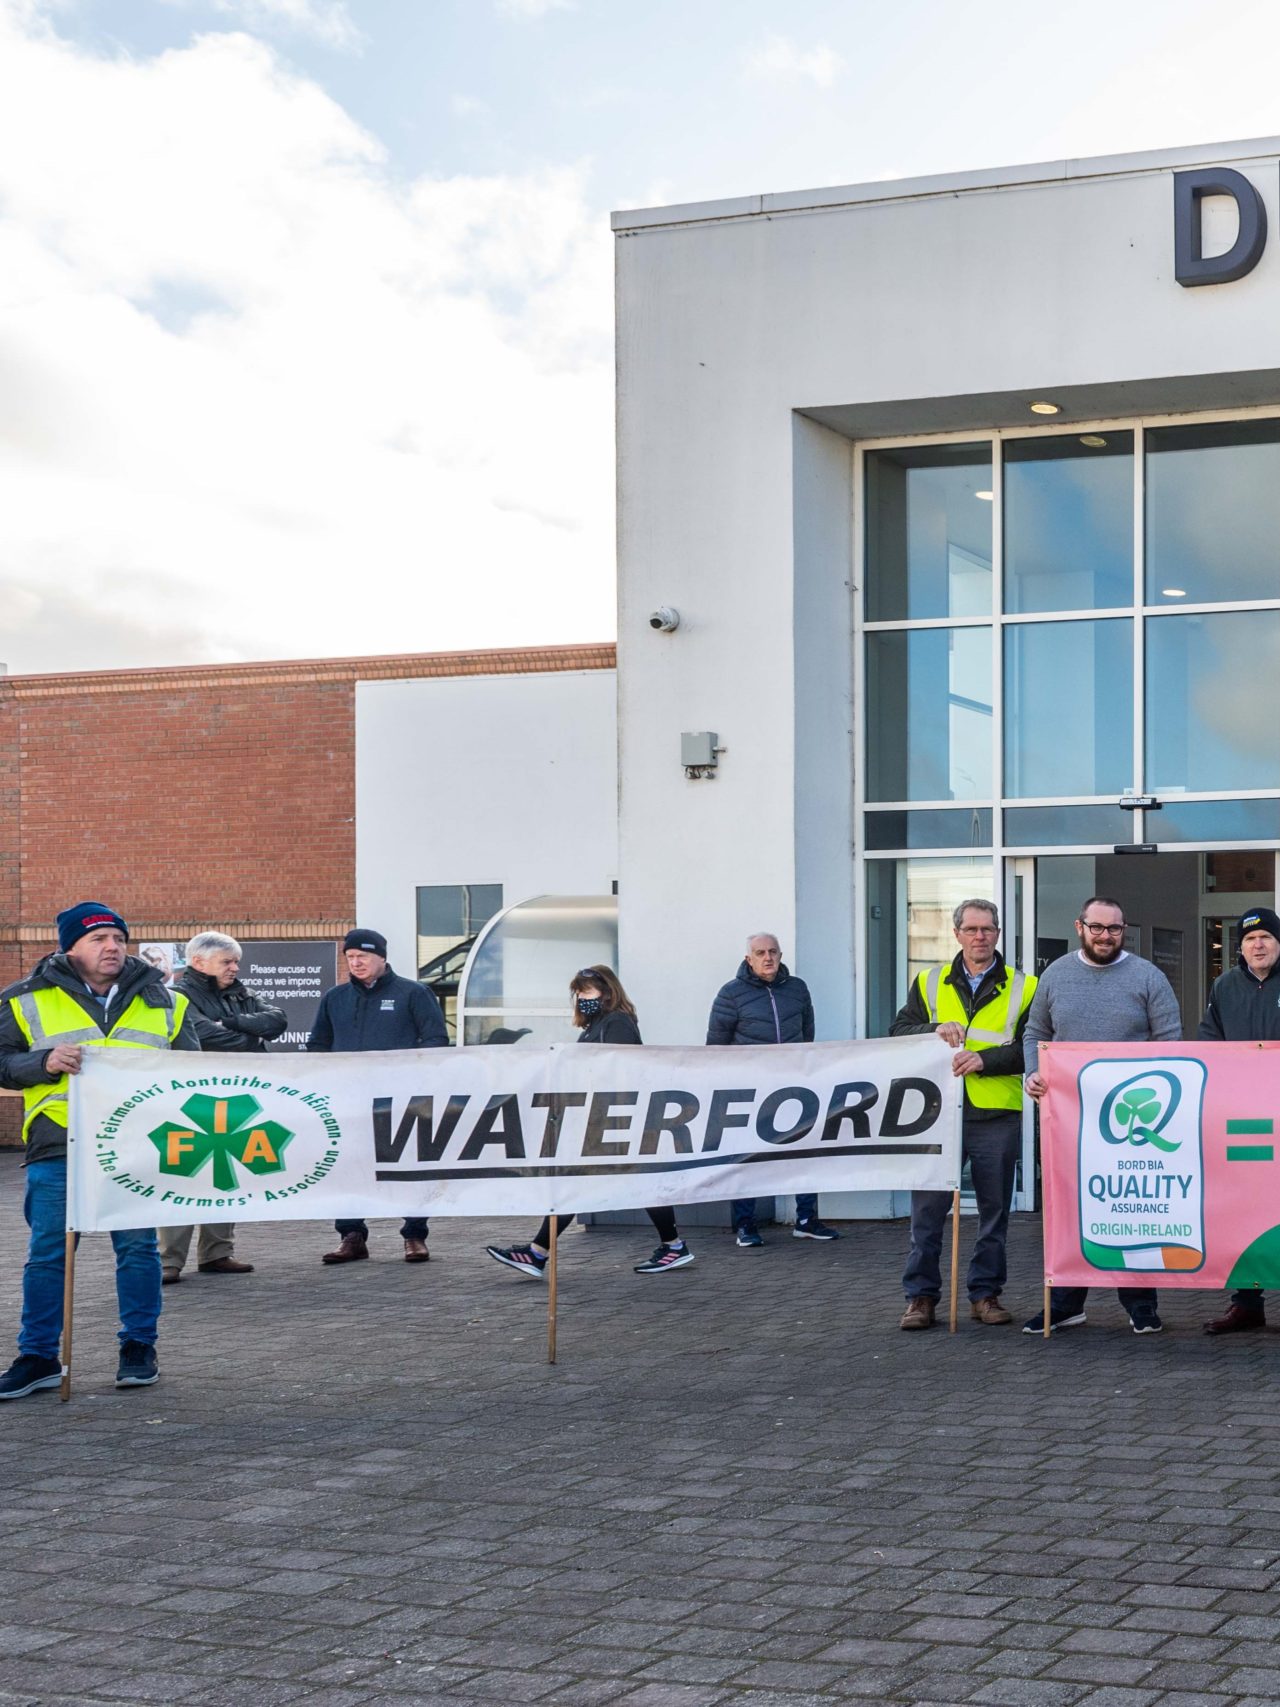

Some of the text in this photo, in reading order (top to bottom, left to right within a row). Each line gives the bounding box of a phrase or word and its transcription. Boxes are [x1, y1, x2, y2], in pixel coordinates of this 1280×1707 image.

[250, 964, 321, 974] Please excuse our
[240, 978, 262, 986] rance
[287, 976, 321, 987] improve
[276, 989, 321, 999] experience
[271, 1031, 312, 1043] UNNE
[170, 1076, 272, 1091] Aontaithe
[277, 1085, 301, 1097] na
[373, 1077, 942, 1163] WATERFORD
[1118, 1160, 1164, 1170] BORD BIA
[96, 1150, 340, 1207] The Irish Farmers' Association
[1088, 1174, 1193, 1202] QUALITY
[1111, 1203, 1169, 1214] ASSURANCE
[1090, 1223, 1192, 1237] ORIGIN-IRELAND
